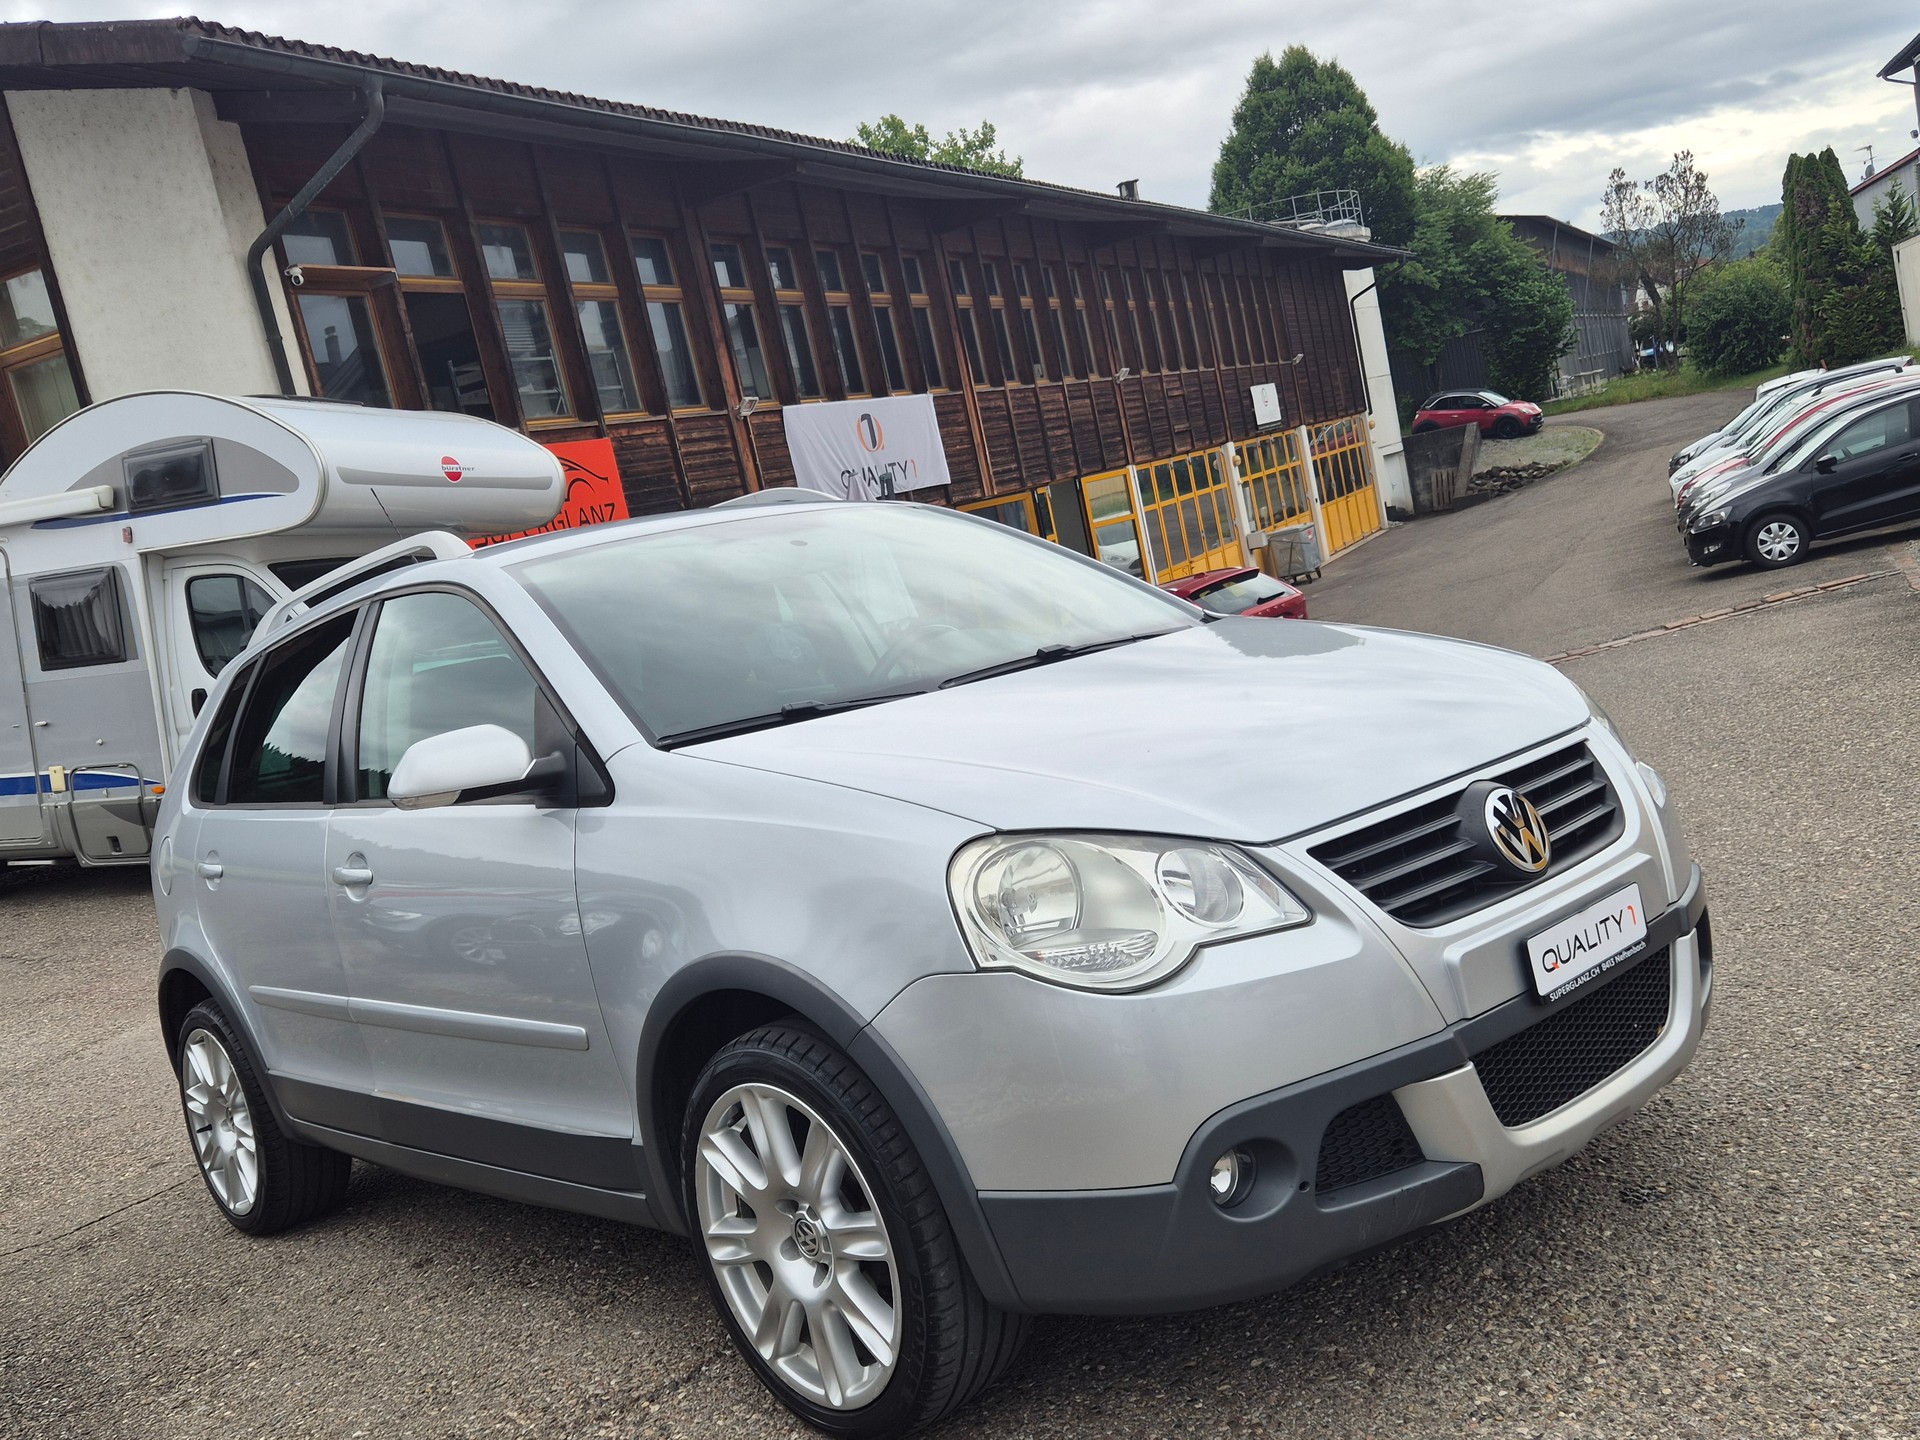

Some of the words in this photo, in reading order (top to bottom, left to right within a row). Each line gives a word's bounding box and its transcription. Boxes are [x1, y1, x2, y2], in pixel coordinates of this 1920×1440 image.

[1542, 910, 1623, 973] QUALITY
[1549, 967, 1600, 1001] SUPERGLANZ.CH
[1601, 959, 1615, 971] 8413
